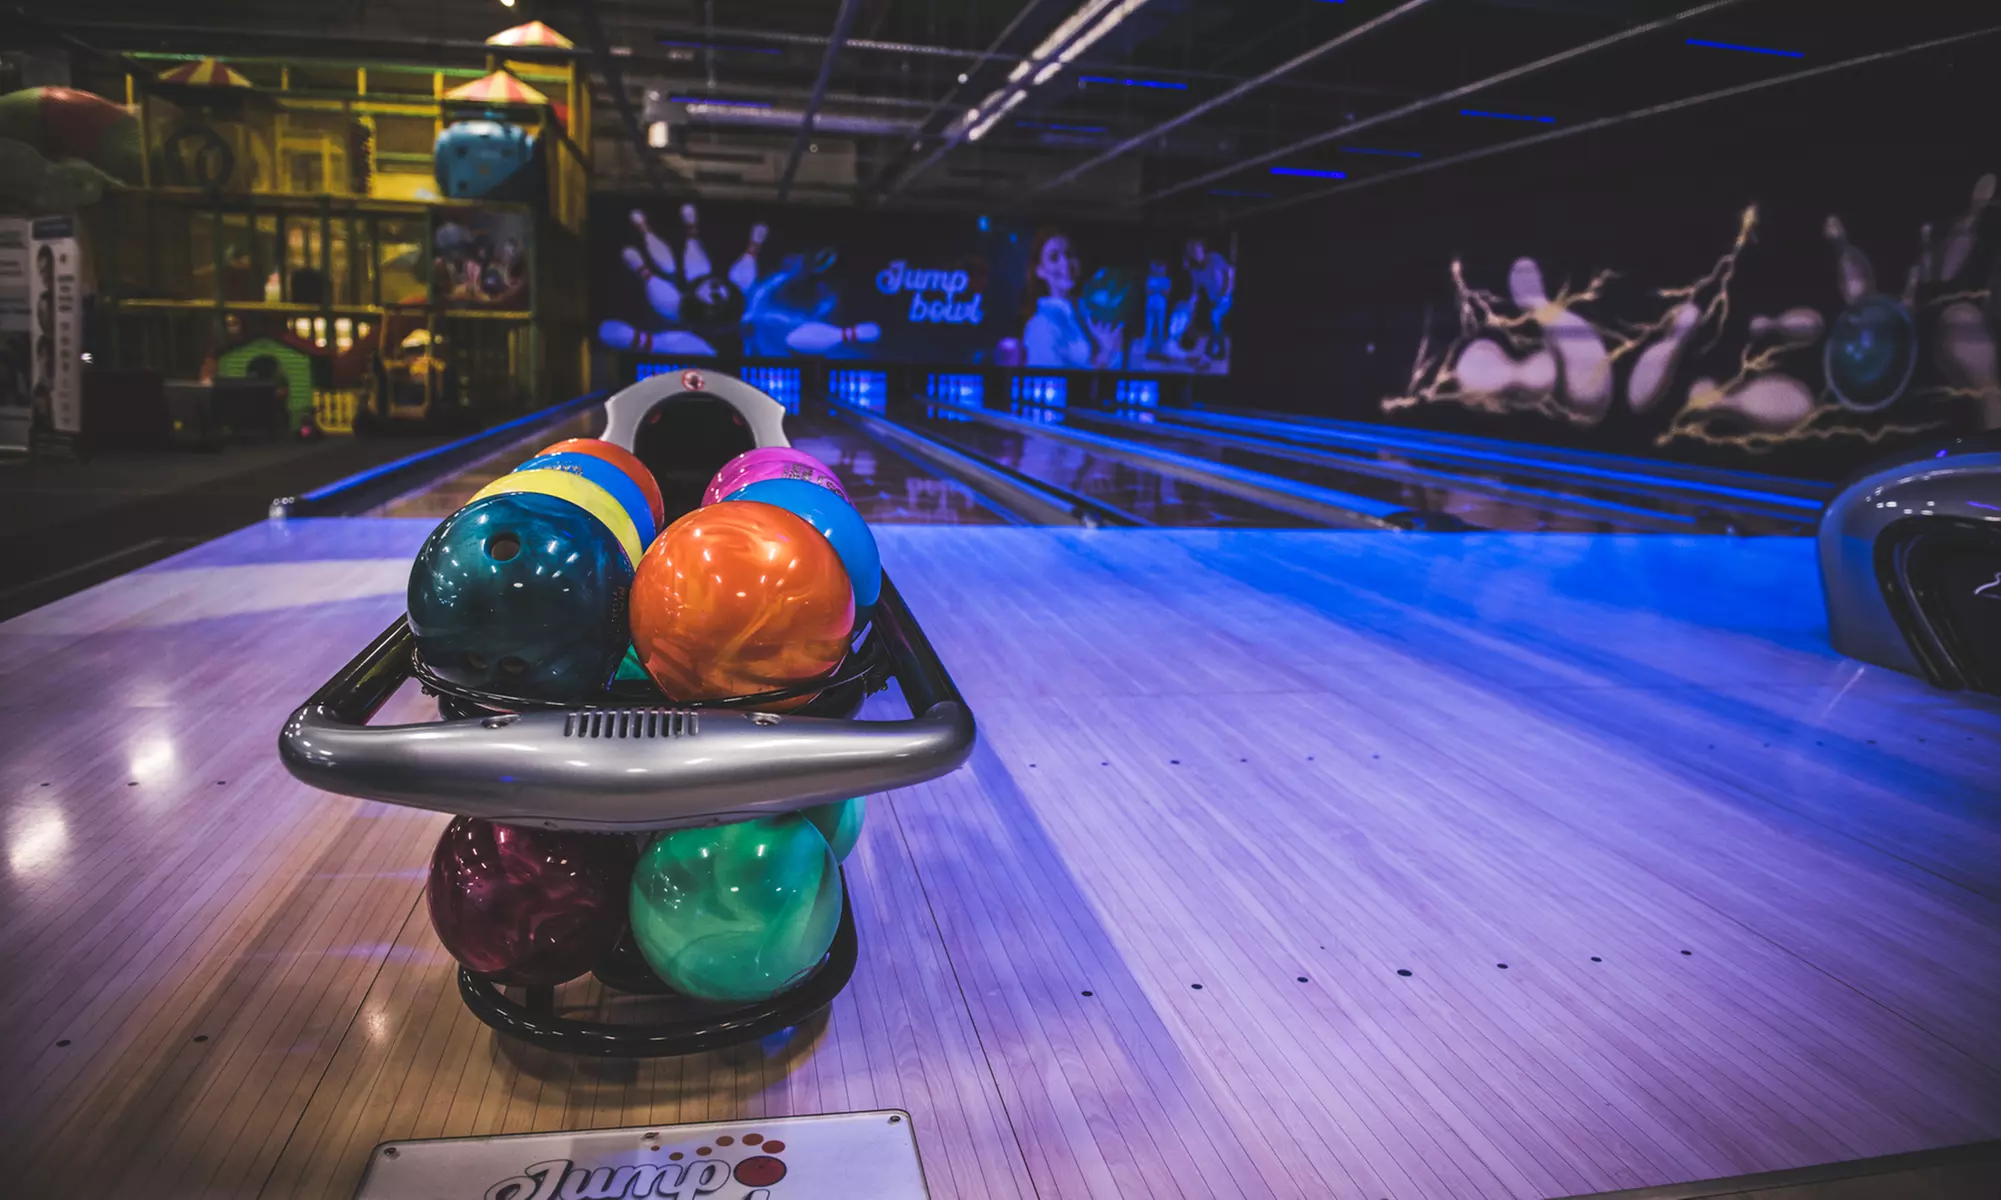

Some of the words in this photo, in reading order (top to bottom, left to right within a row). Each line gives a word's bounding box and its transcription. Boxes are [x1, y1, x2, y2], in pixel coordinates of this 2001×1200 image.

[876, 260, 968, 303] Jump
[908, 293, 984, 325] bowl
[484, 1158, 731, 1200] Jump
